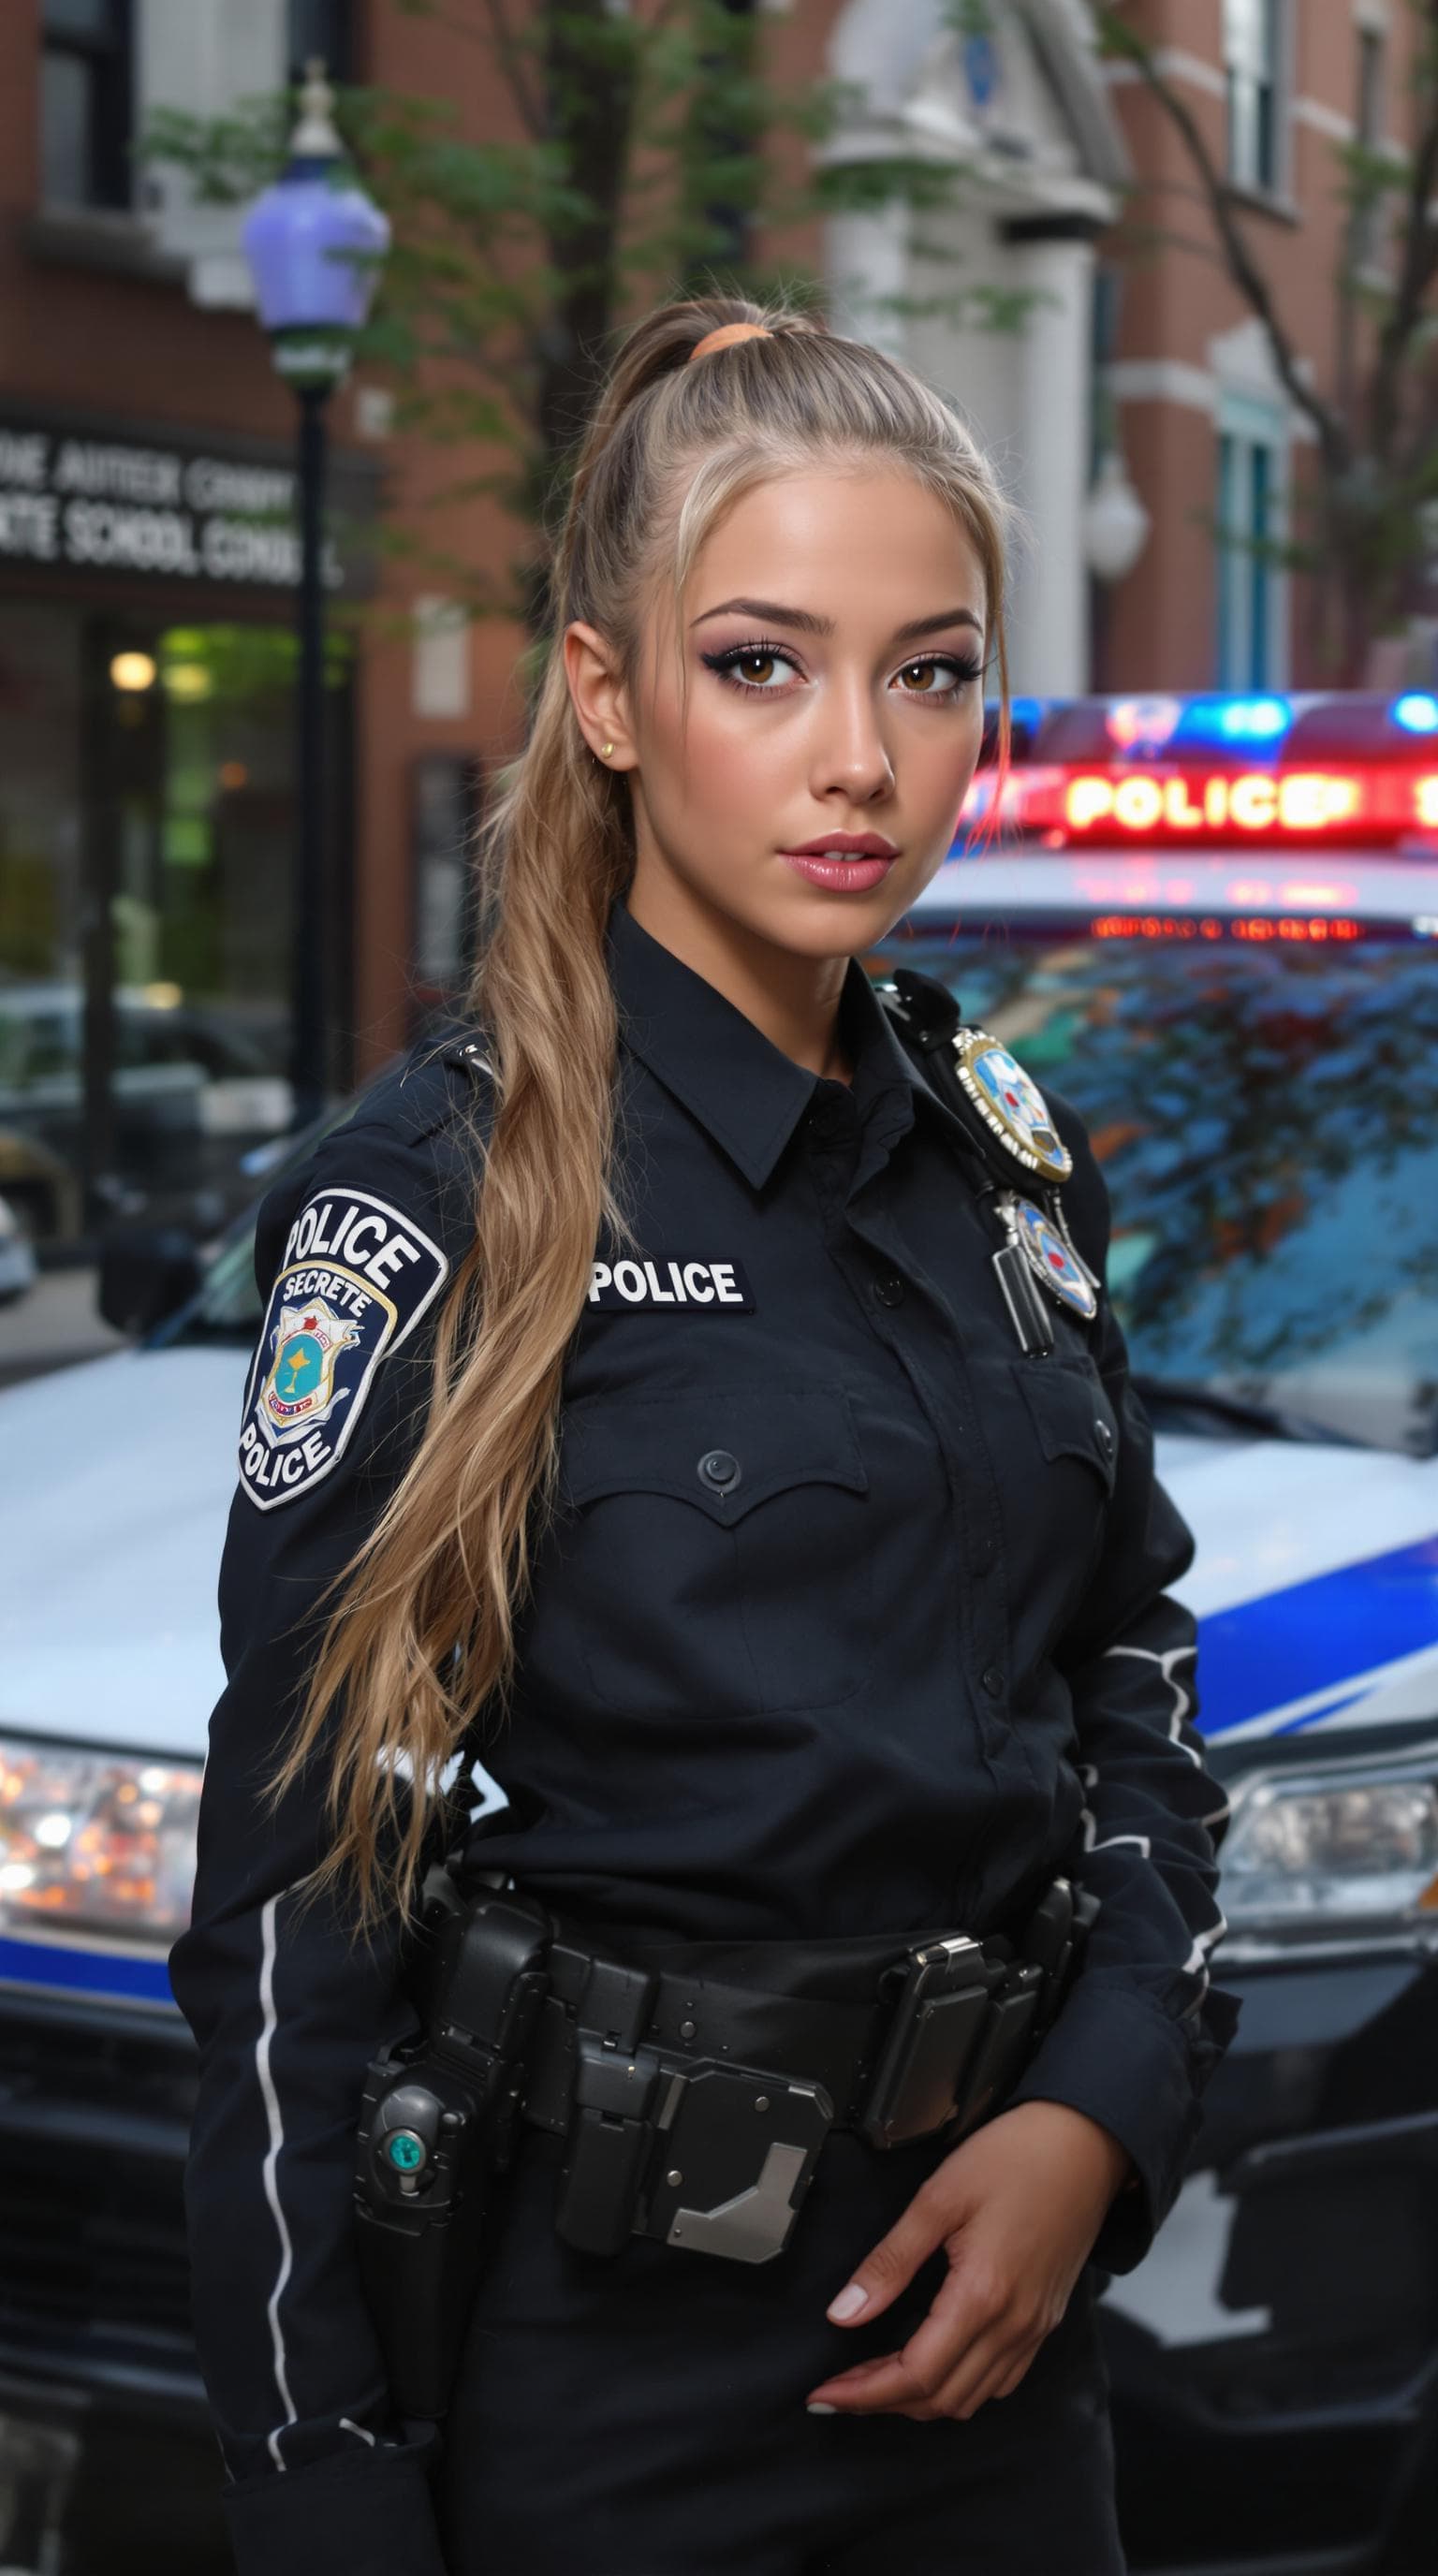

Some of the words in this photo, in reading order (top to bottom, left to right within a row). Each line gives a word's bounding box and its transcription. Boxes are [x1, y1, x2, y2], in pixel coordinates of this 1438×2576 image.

[64, 499, 199, 576] SCHOOL
[286, 1204, 421, 1290] POLICE
[283, 1270, 373, 1318] SECRETE
[588, 1260, 743, 1303] POLICE
[240, 1423, 330, 1487] POLICE
